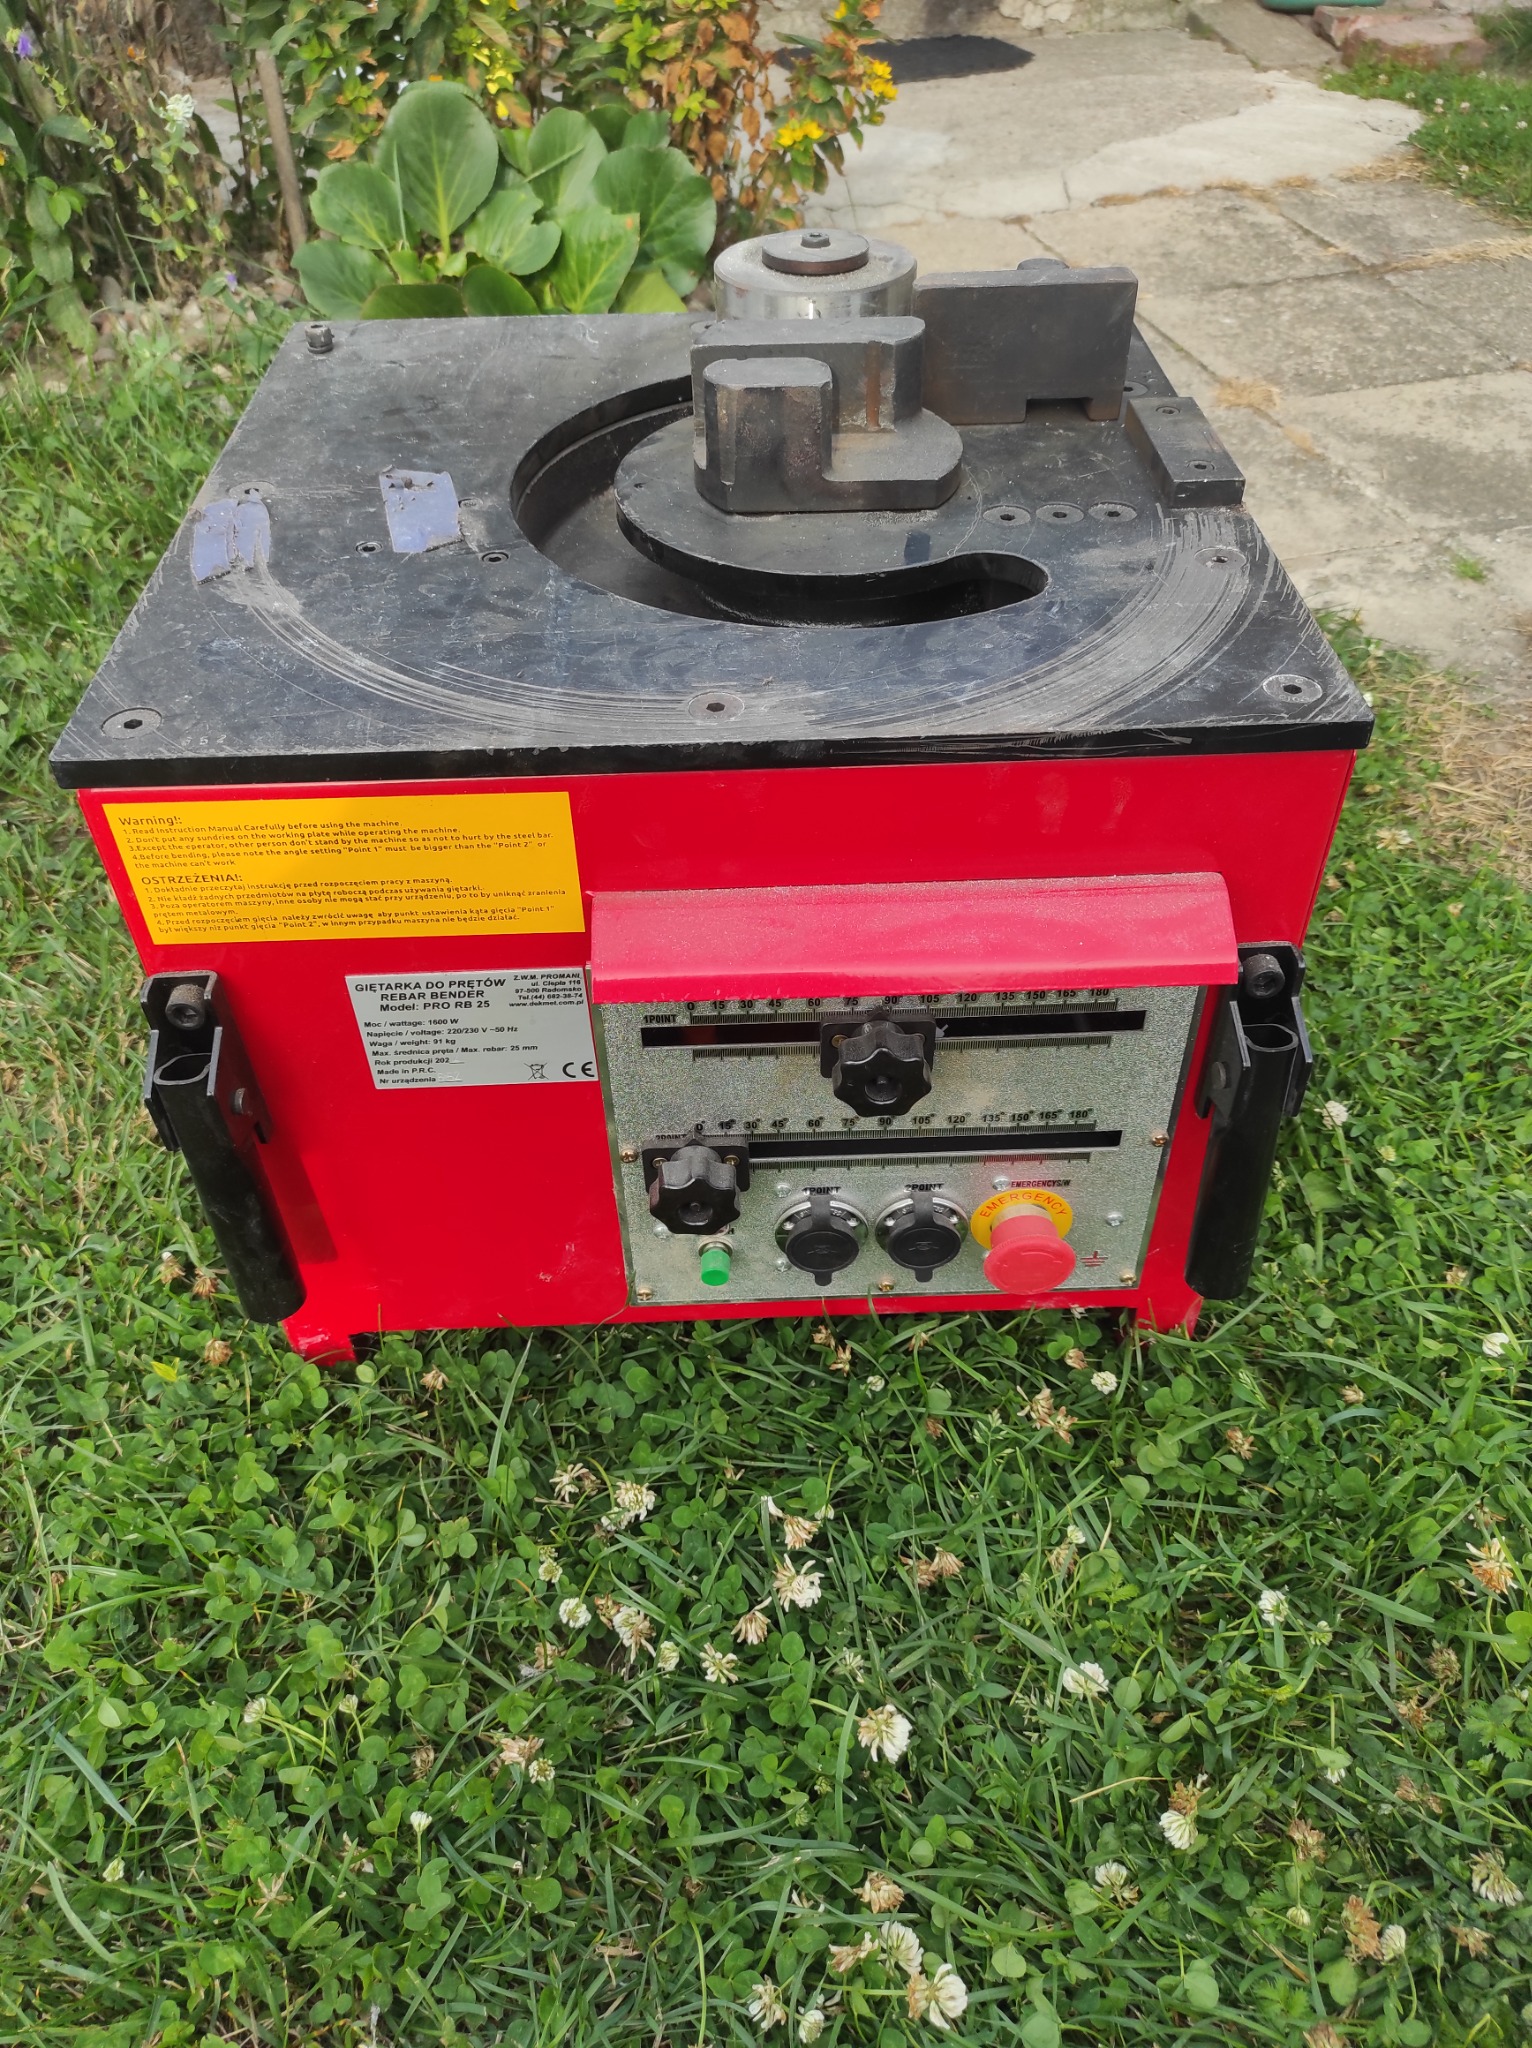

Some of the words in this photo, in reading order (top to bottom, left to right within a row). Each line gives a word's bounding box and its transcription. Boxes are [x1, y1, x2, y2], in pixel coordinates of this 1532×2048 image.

[244, 823, 286, 831] Carefully
[268, 831, 305, 839] working
[307, 830, 329, 838] plate
[358, 829, 401, 837] operating
[284, 848, 307, 856] angle
[424, 843, 452, 851] bigger
[355, 983, 422, 993] GIĘTARKA
[426, 981, 445, 990] DO
[448, 978, 505, 989] PRĘTÓW
[381, 992, 426, 1001] REBAR
[431, 990, 484, 999] BENDER
[712, 1001, 725, 1010] 15
[741, 1000, 753, 1008] 30
[768, 999, 782, 1007] 45
[807, 998, 821, 1007] 60
[845, 997, 858, 1006] 75
[885, 996, 897, 1005] 90
[920, 994, 940, 1003] 105
[957, 993, 977, 1002] 120
[996, 991, 1015, 1001] 135
[1026, 991, 1046, 999] 150
[1057, 988, 1076, 998] 165
[1089, 988, 1109, 996] 180
[380, 1003, 419, 1012] Model:
[423, 1002, 451, 1010] PRO
[455, 1001, 473, 1009] RB
[562, 1062, 594, 1078] CE
[392, 1076, 436, 1084] urządzenia
[980, 1192, 1067, 1218] EMERGENCY
